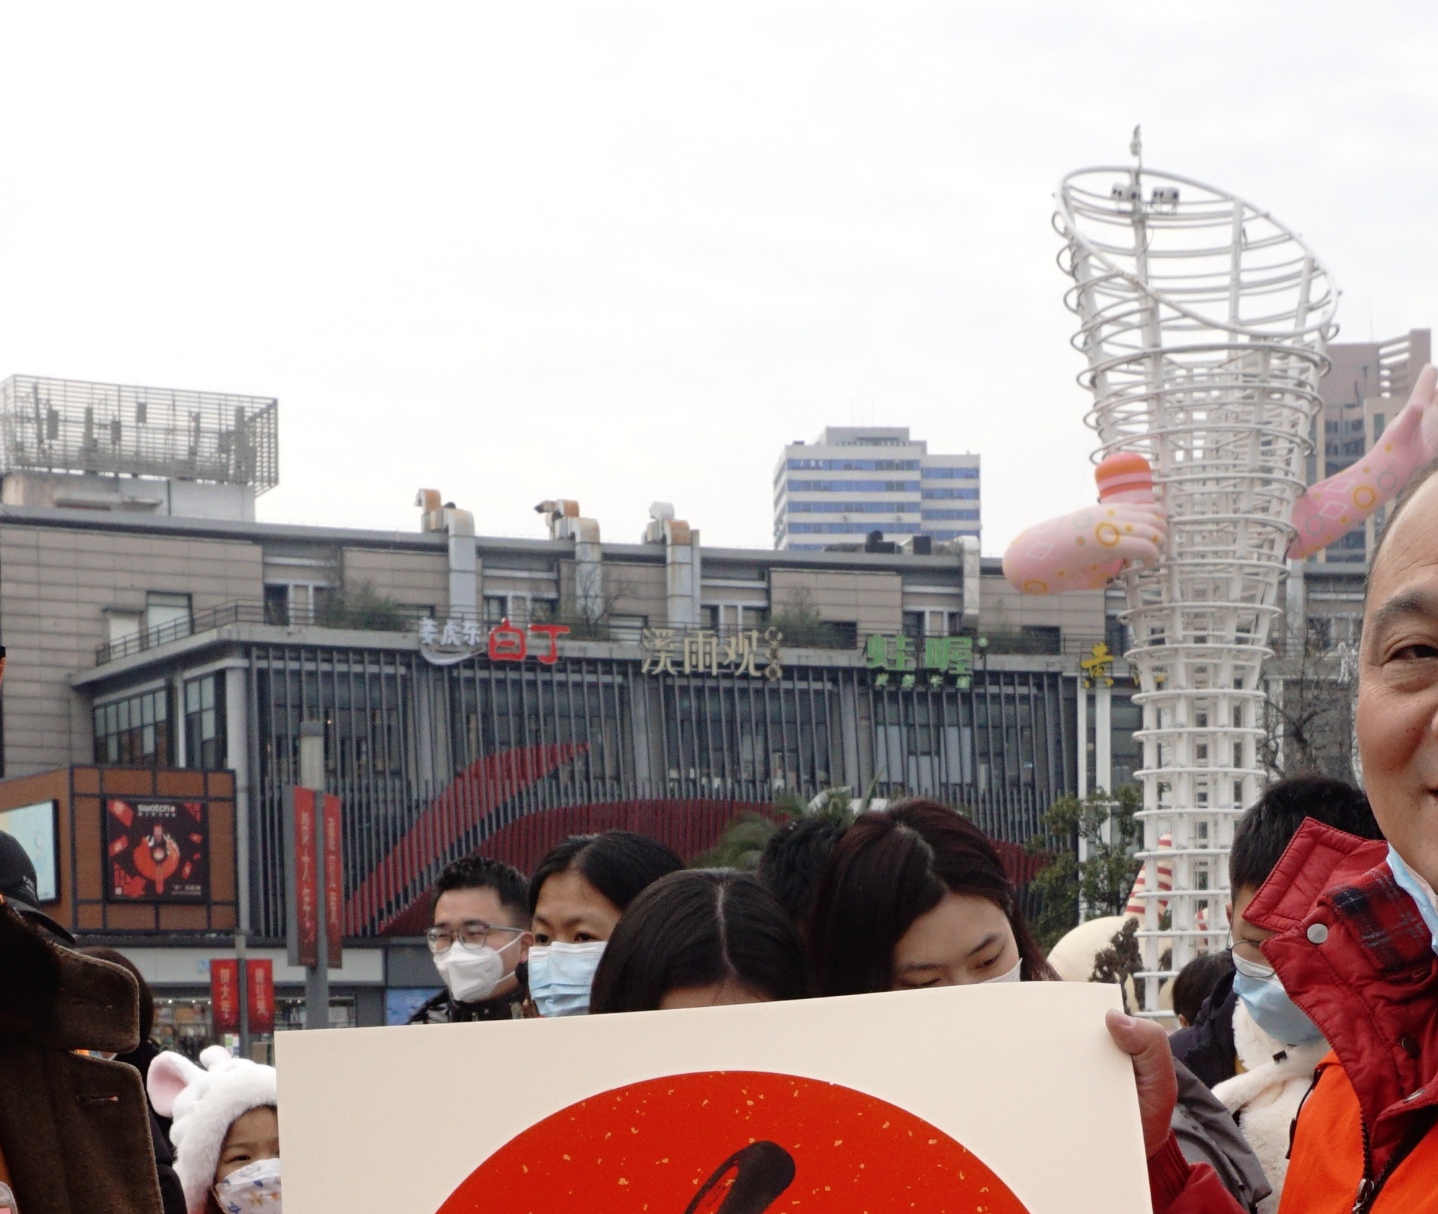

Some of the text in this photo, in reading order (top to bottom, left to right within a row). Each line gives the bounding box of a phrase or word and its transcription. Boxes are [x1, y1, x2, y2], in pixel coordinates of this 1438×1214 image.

[489, 618, 570, 664] 白丁
[641, 627, 762, 676] 溪雨观
